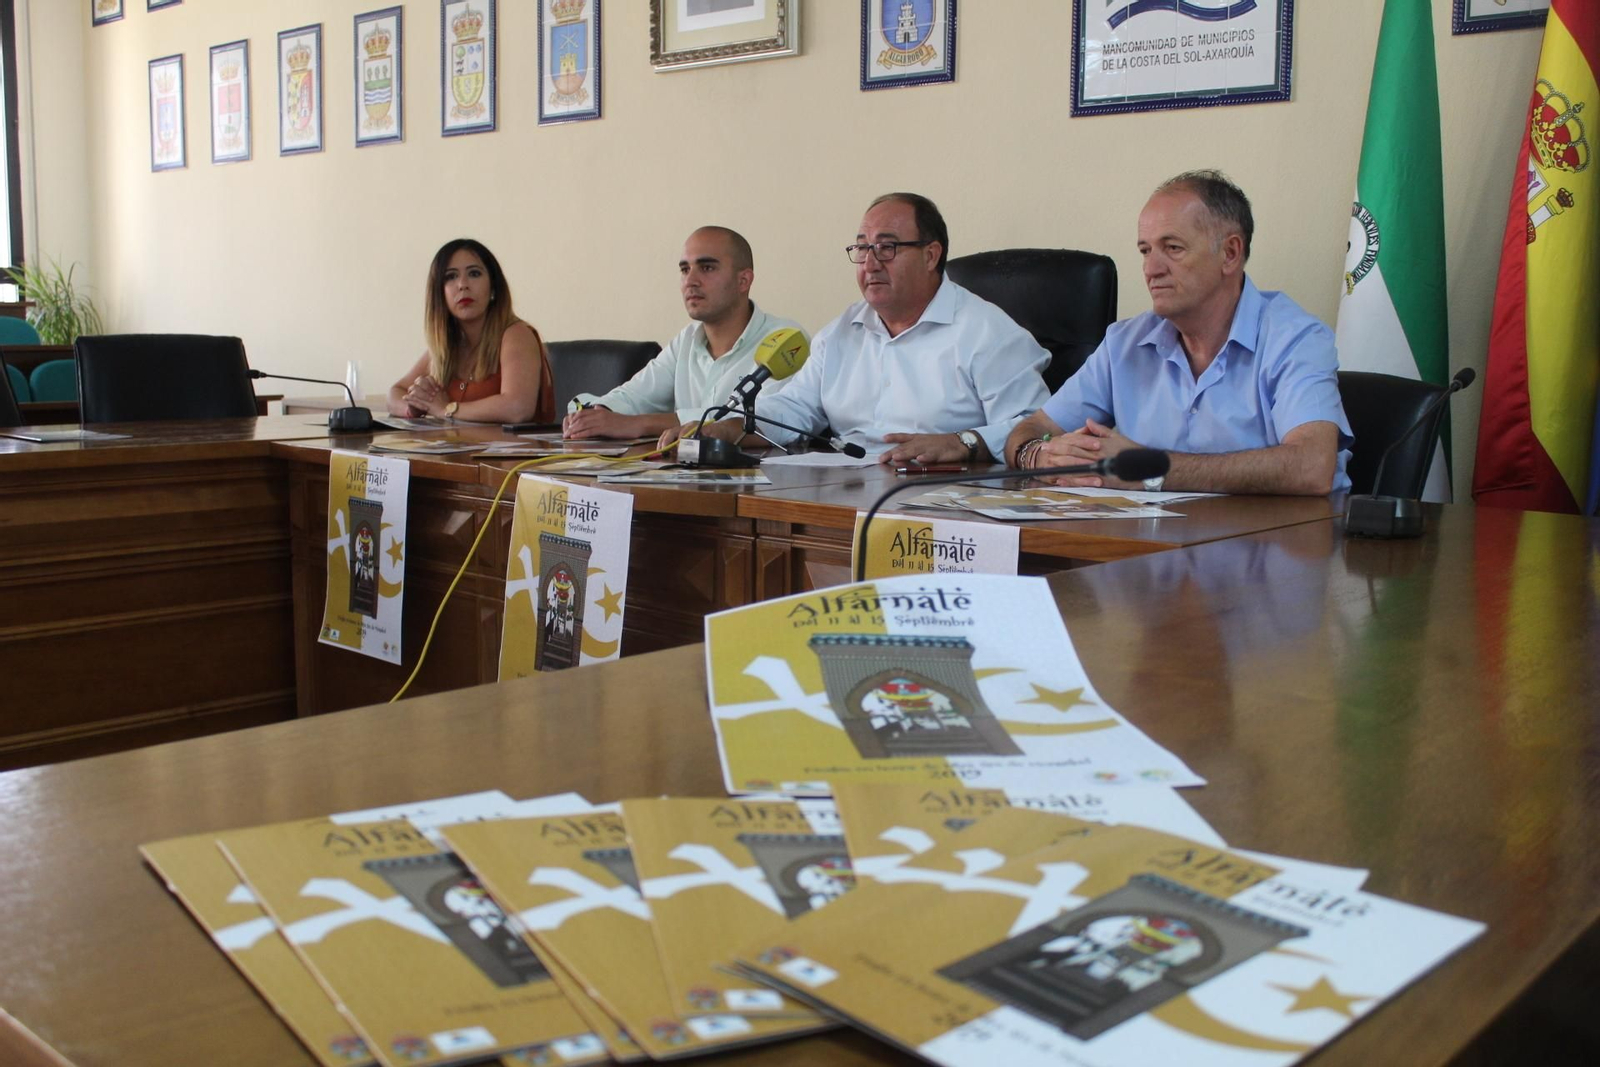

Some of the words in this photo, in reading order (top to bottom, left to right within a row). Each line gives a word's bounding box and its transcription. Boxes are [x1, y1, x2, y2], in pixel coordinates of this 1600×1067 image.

[1102, 37, 1177, 55] MANCOMUNIDAD
[1181, 35, 1194, 48] DE
[1198, 29, 1255, 45] MUNICIPIOS
[1102, 58, 1115, 71] DE
[1116, 57, 1128, 70] LA
[1130, 54, 1161, 68] COSTA
[1163, 52, 1181, 65] DEL
[1183, 44, 1255, 63] SOL-AXARQUÍA
